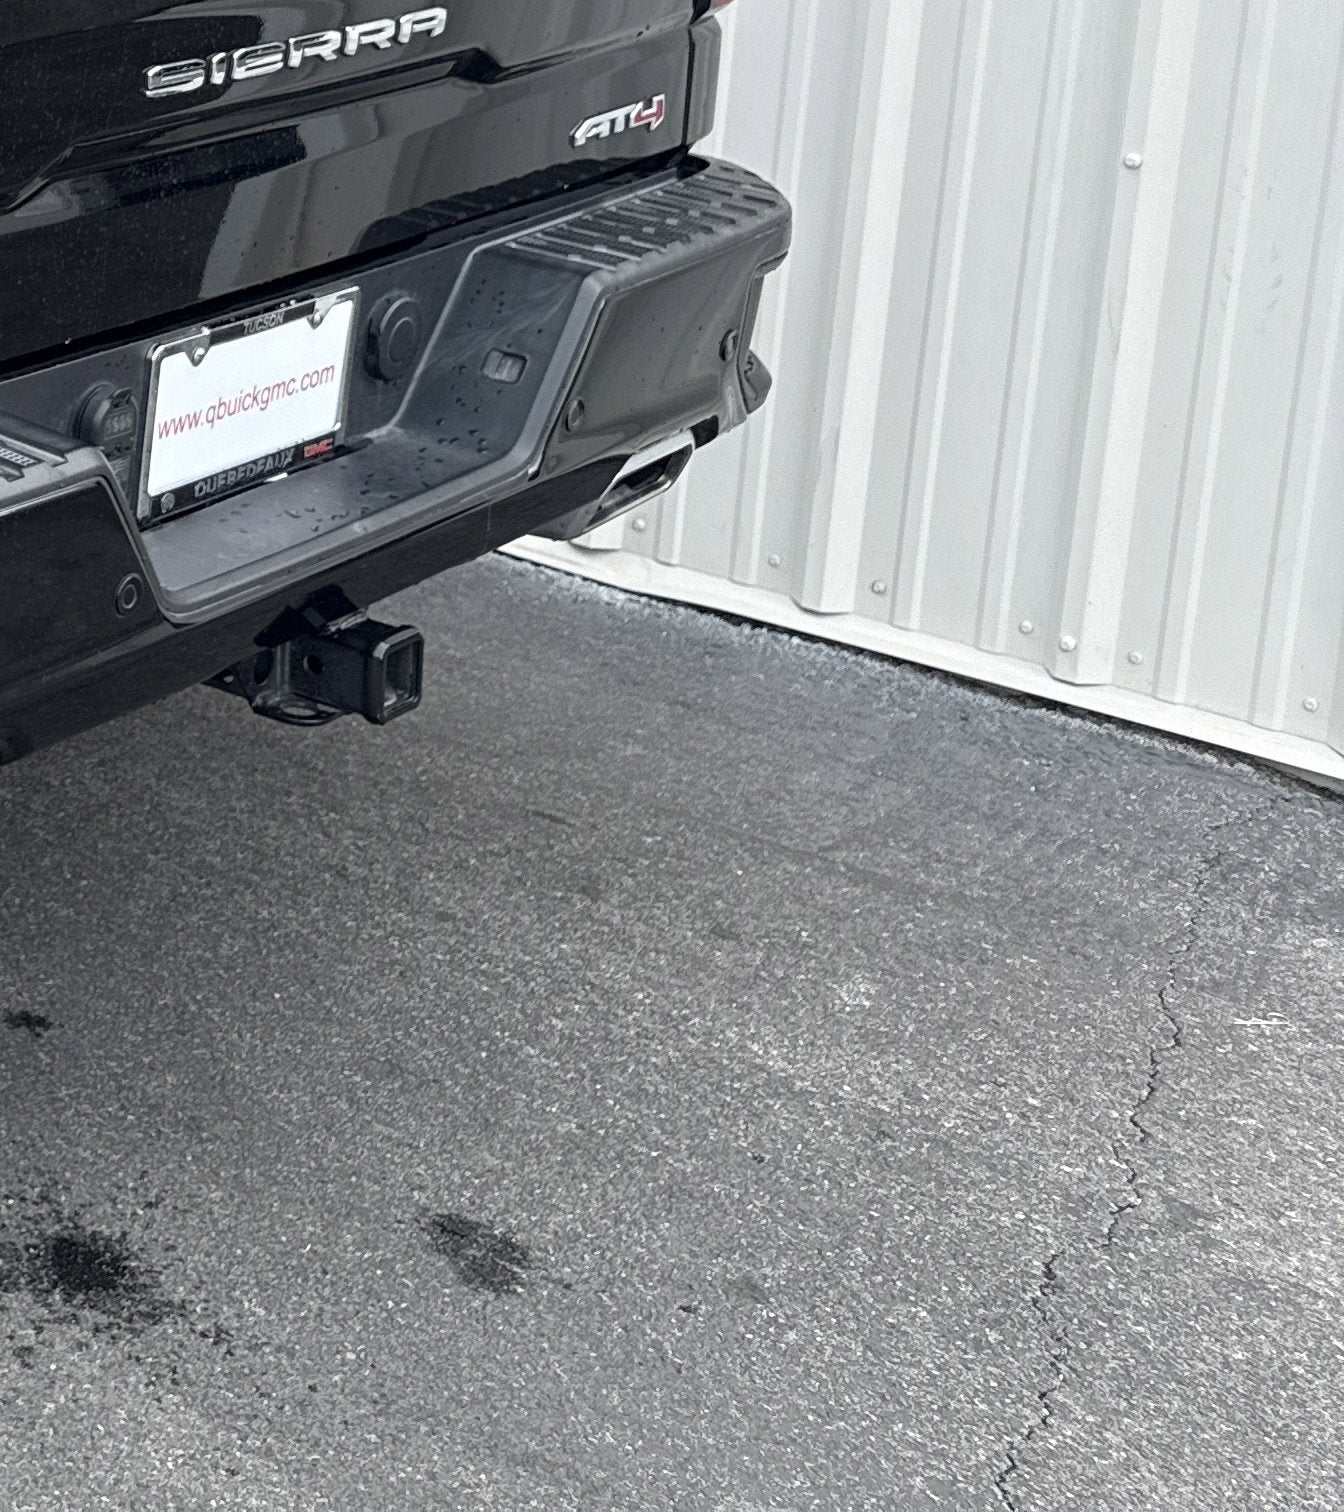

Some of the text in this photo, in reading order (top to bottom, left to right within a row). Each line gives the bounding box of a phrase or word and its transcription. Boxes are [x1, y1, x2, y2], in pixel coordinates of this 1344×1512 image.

[143, 7, 447, 97] SIERRA
[569, 93, 665, 148] AT4
[243, 311, 285, 335] TUCSON
[157, 363, 335, 440] www.qbuickgmc.com
[303, 438, 333, 458] GMC
